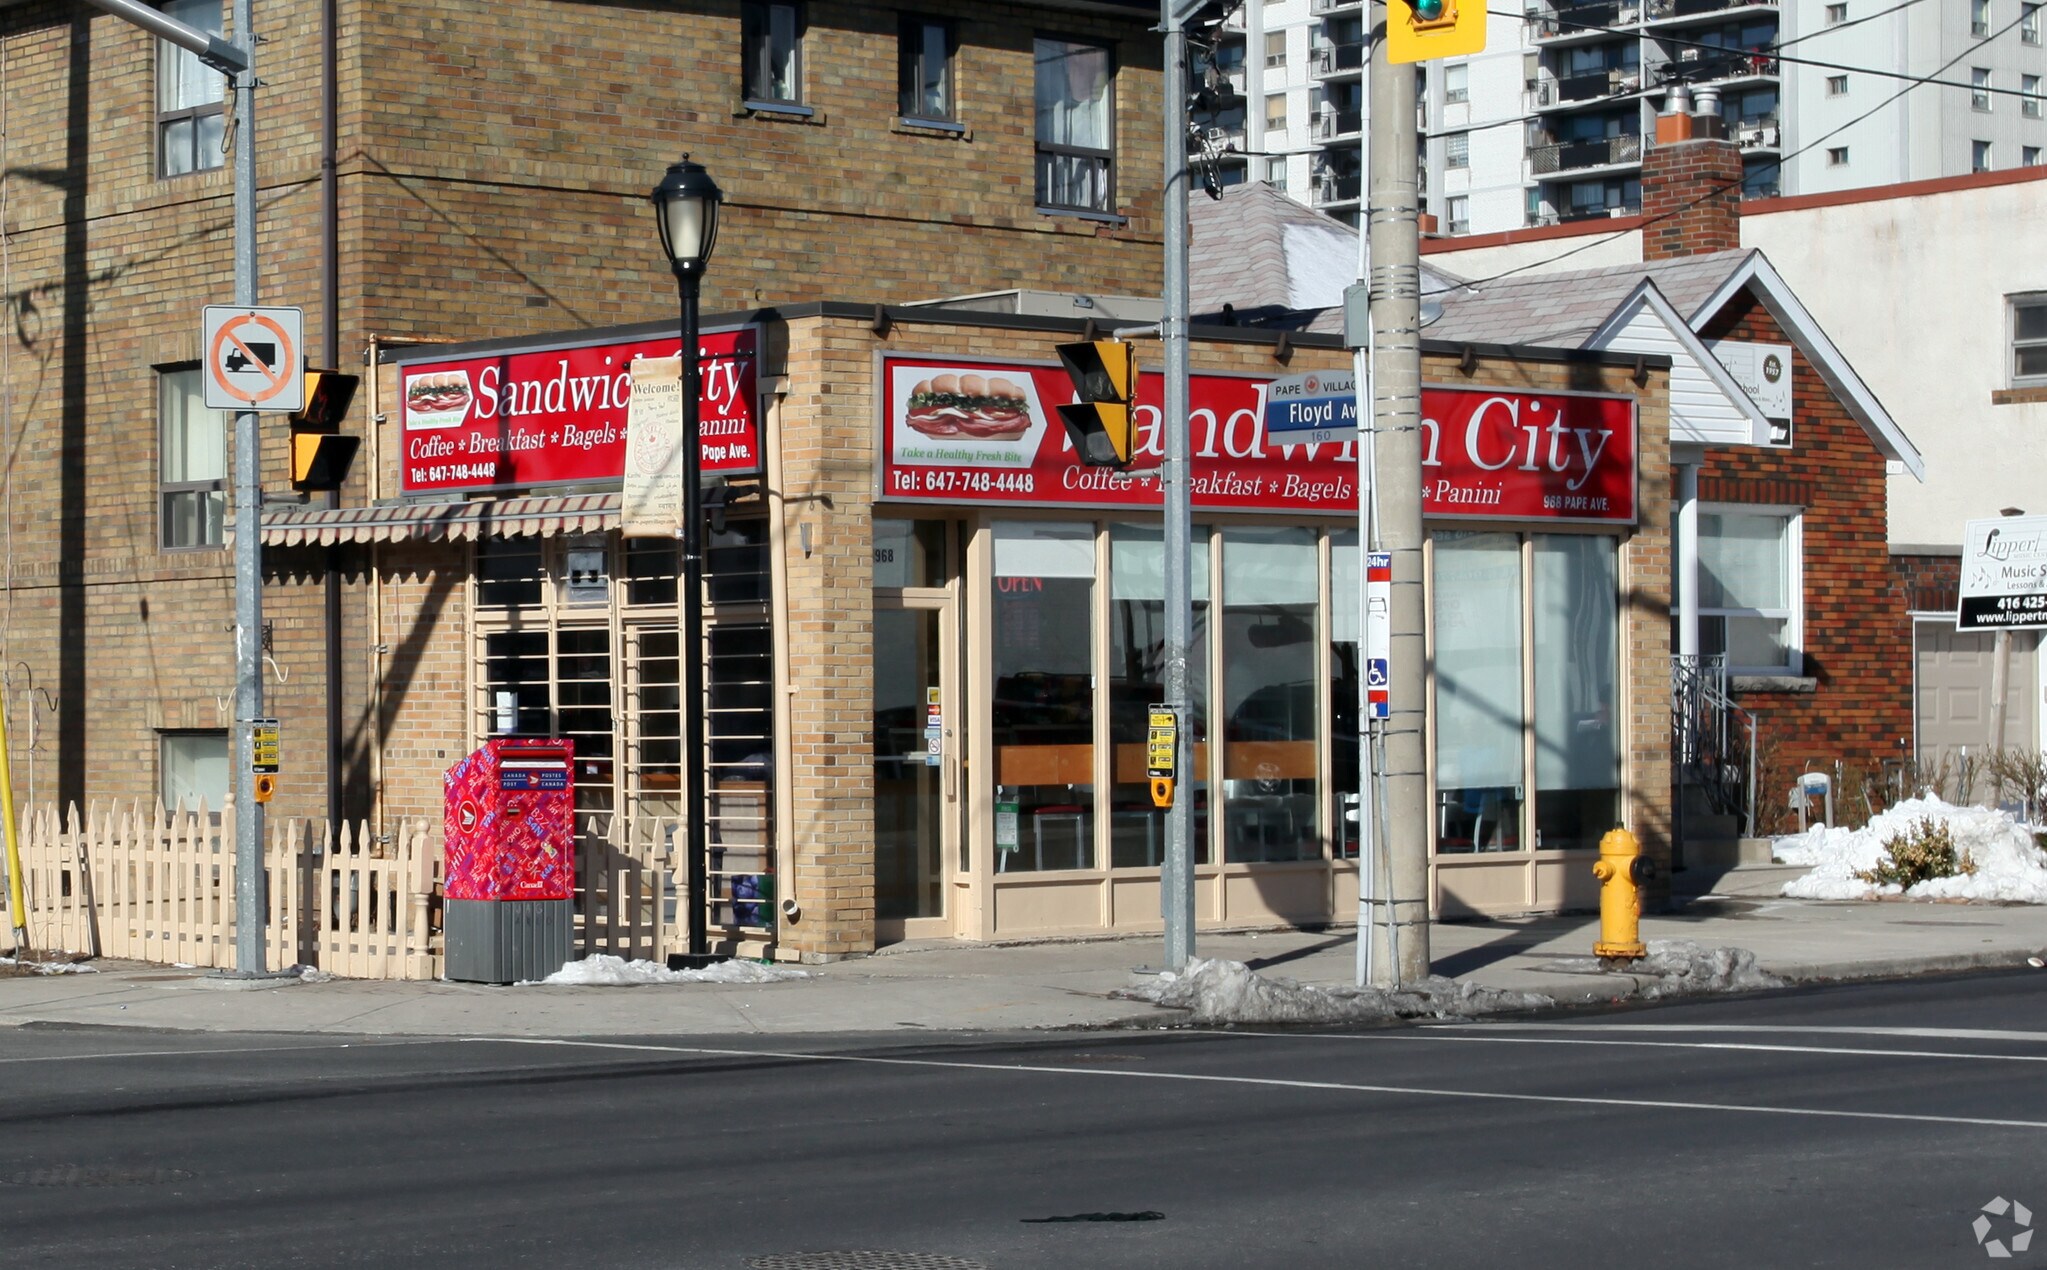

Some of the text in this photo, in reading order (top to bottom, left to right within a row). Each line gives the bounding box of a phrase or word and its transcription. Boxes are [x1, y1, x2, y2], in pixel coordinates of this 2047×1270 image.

[1765, 366, 1779, 375] 1957
[474, 353, 643, 419] Sandwic
[633, 381, 680, 394] Welcome!
[1275, 385, 1300, 396] PAPE
[1289, 401, 1357, 426] Floyd Av
[410, 410, 747, 460] Coffee Breakfast Bagels anini
[1312, 430, 1331, 441] 160
[1465, 397, 1613, 490] City
[702, 443, 751, 463] Pape Ave.
[900, 447, 1022, 463] Take a Healthy Fresh Bite
[411, 462, 496, 483] Tel: 647-748-4448
[893, 470, 1034, 493] Tel: 647-748-4448
[1281, 473, 1351, 503] Bagels
[1434, 480, 1503, 505] Panini
[1543, 494, 1610, 511] 968 PAPE AVE.
[1977, 528, 2041, 561] Lippert
[875, 549, 894, 563] 968
[1367, 556, 1389, 567] 24hr
[2001, 565, 2037, 579] Music
[2007, 580, 2037, 590] Lessons
[1997, 596, 2021, 610] 416
